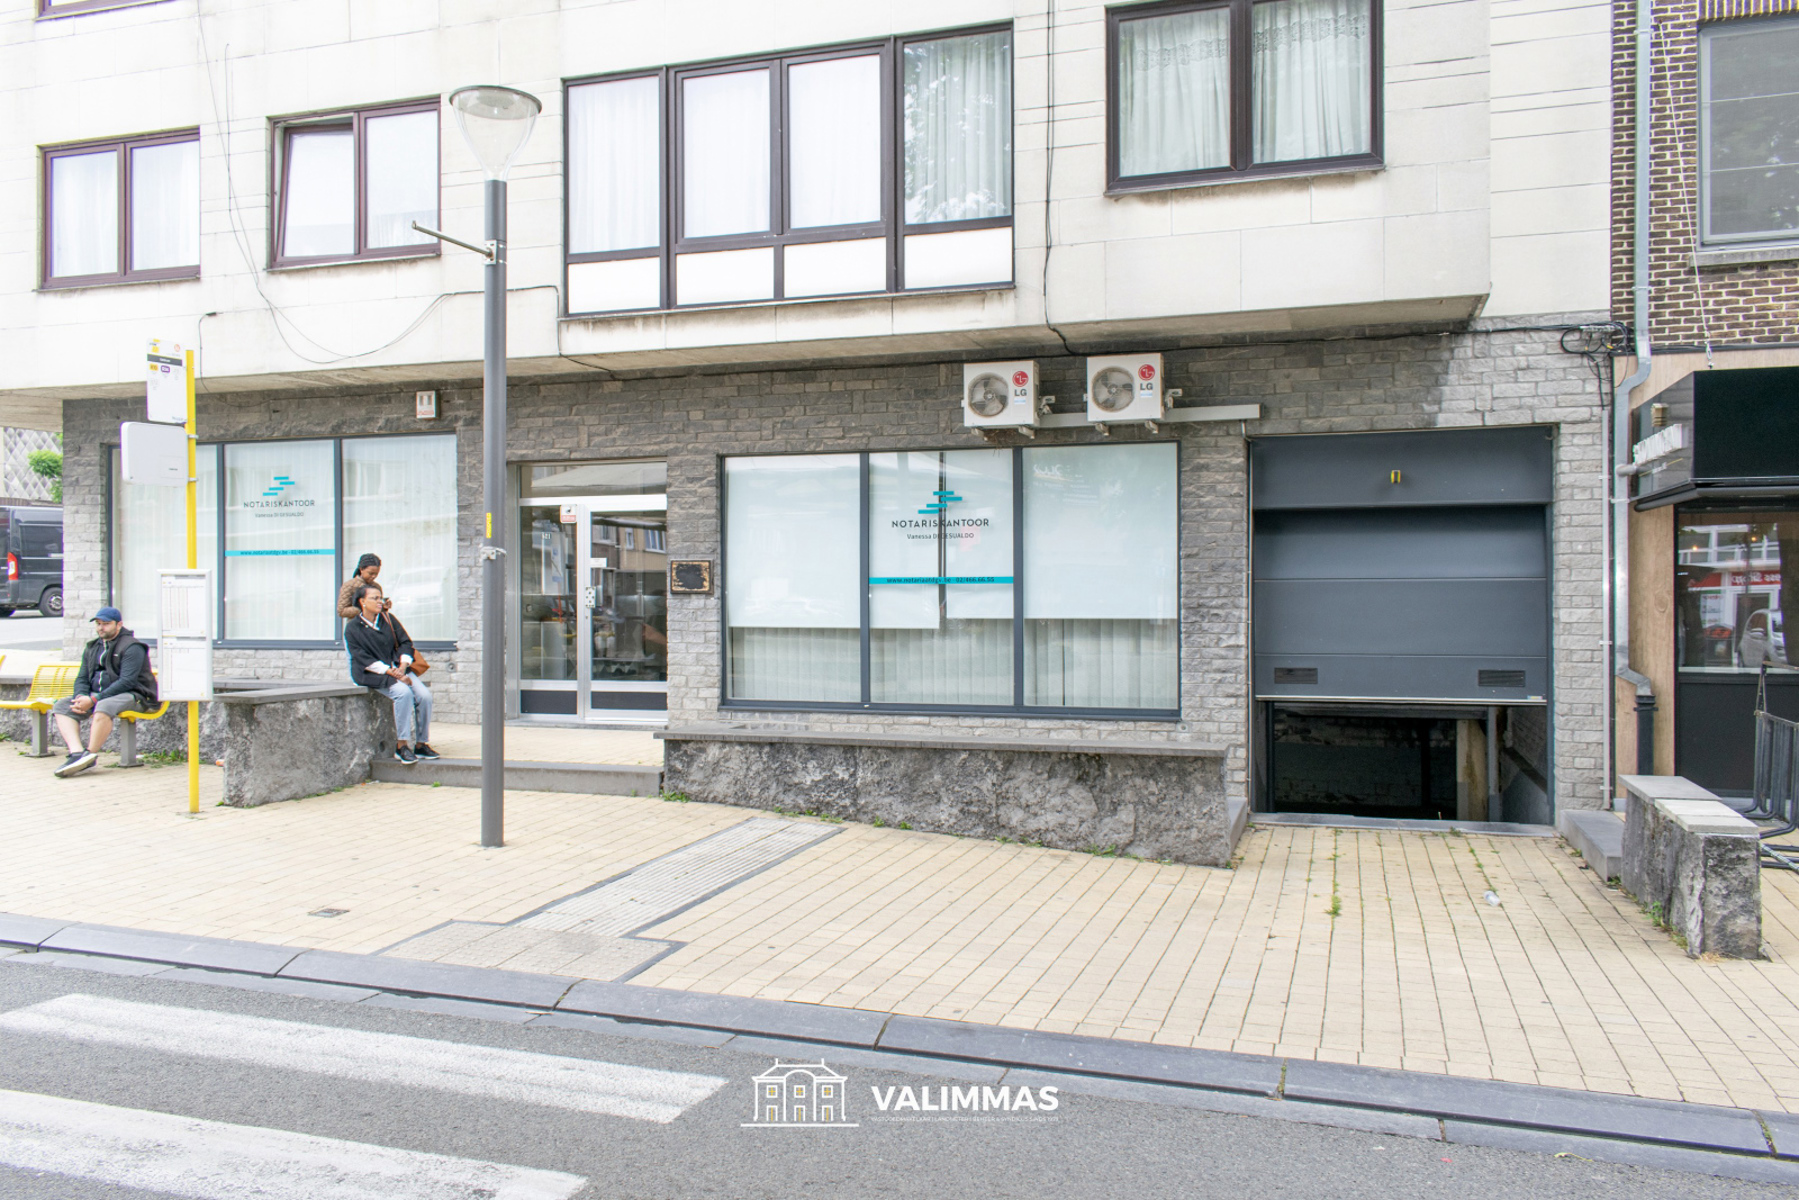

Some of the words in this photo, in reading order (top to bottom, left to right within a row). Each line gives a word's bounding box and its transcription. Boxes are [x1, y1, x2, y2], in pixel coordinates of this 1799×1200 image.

[1140, 382, 1153, 391] LG
[1014, 388, 1028, 397] LG
[243, 499, 315, 509] NOTARISKANTOOR
[891, 518, 989, 529] NOTARISKANTOOR
